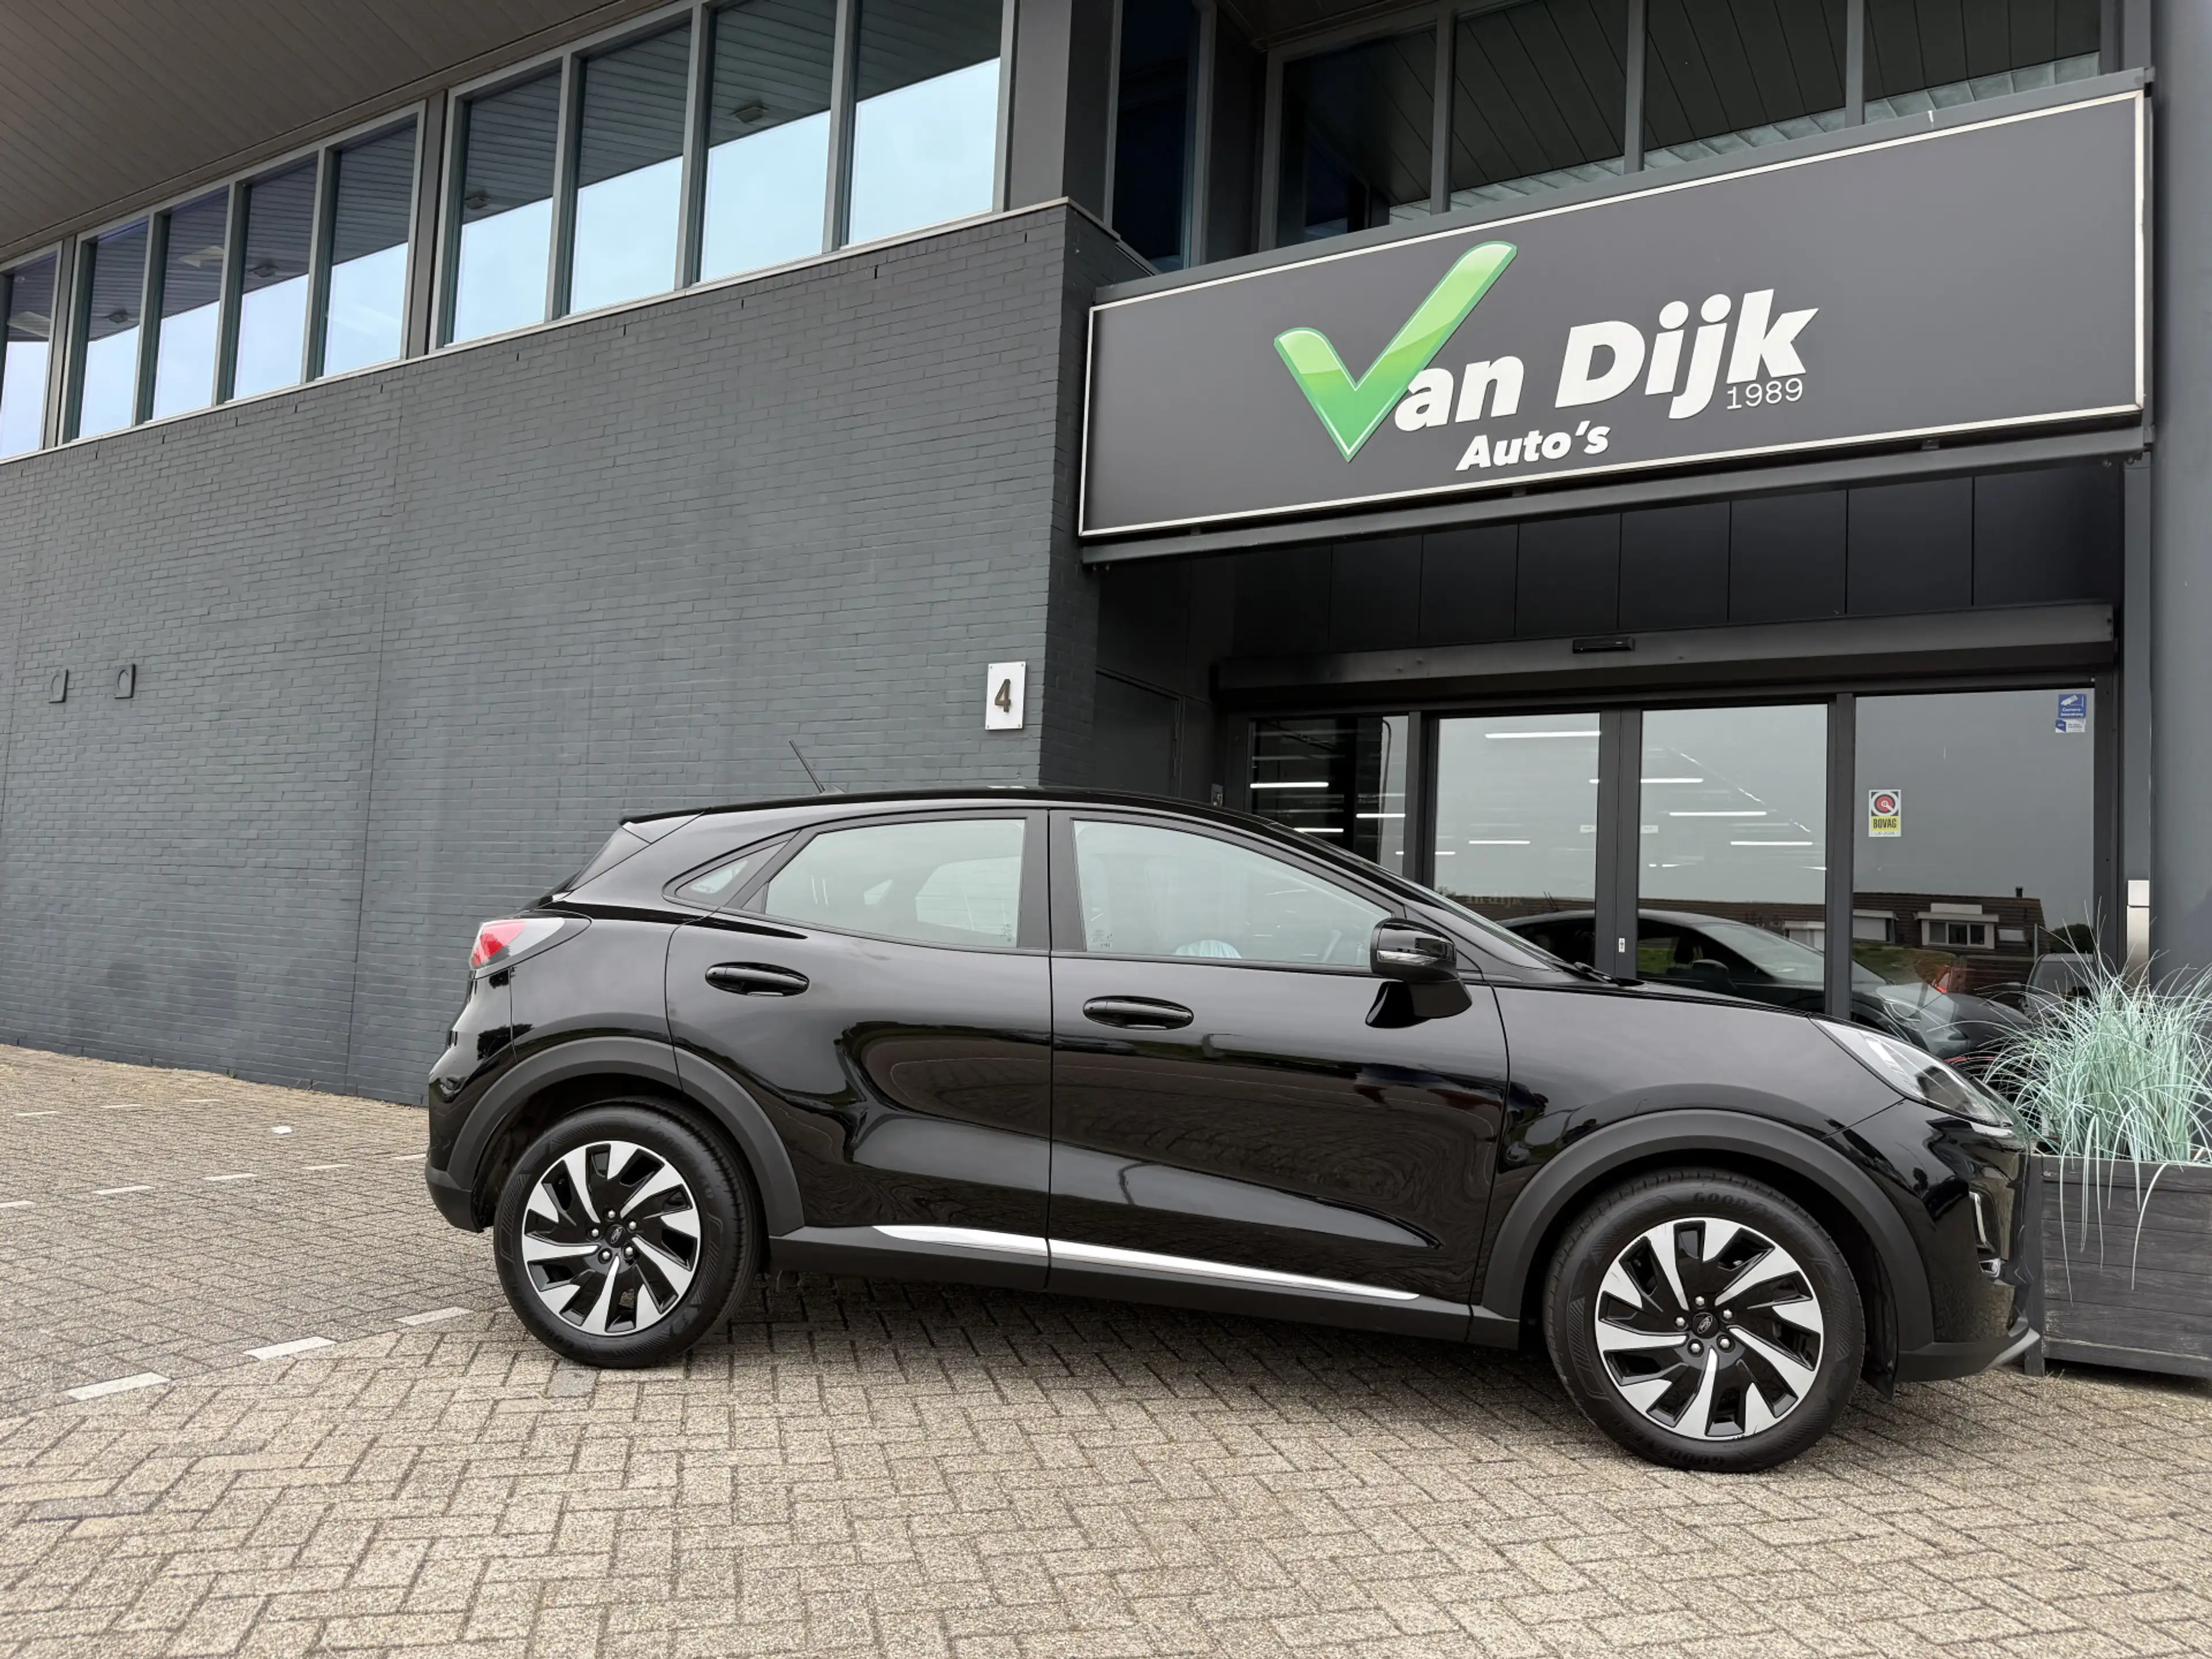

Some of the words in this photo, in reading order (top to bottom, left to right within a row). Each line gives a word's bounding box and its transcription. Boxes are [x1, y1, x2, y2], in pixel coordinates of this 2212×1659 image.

[1555, 289, 1819, 419] Dijk
[1726, 377, 1804, 410] 1989
[1455, 420, 1611, 471] Auto's
[994, 678, 1012, 714] 4
[1873, 819, 1897, 828] BOVAG
